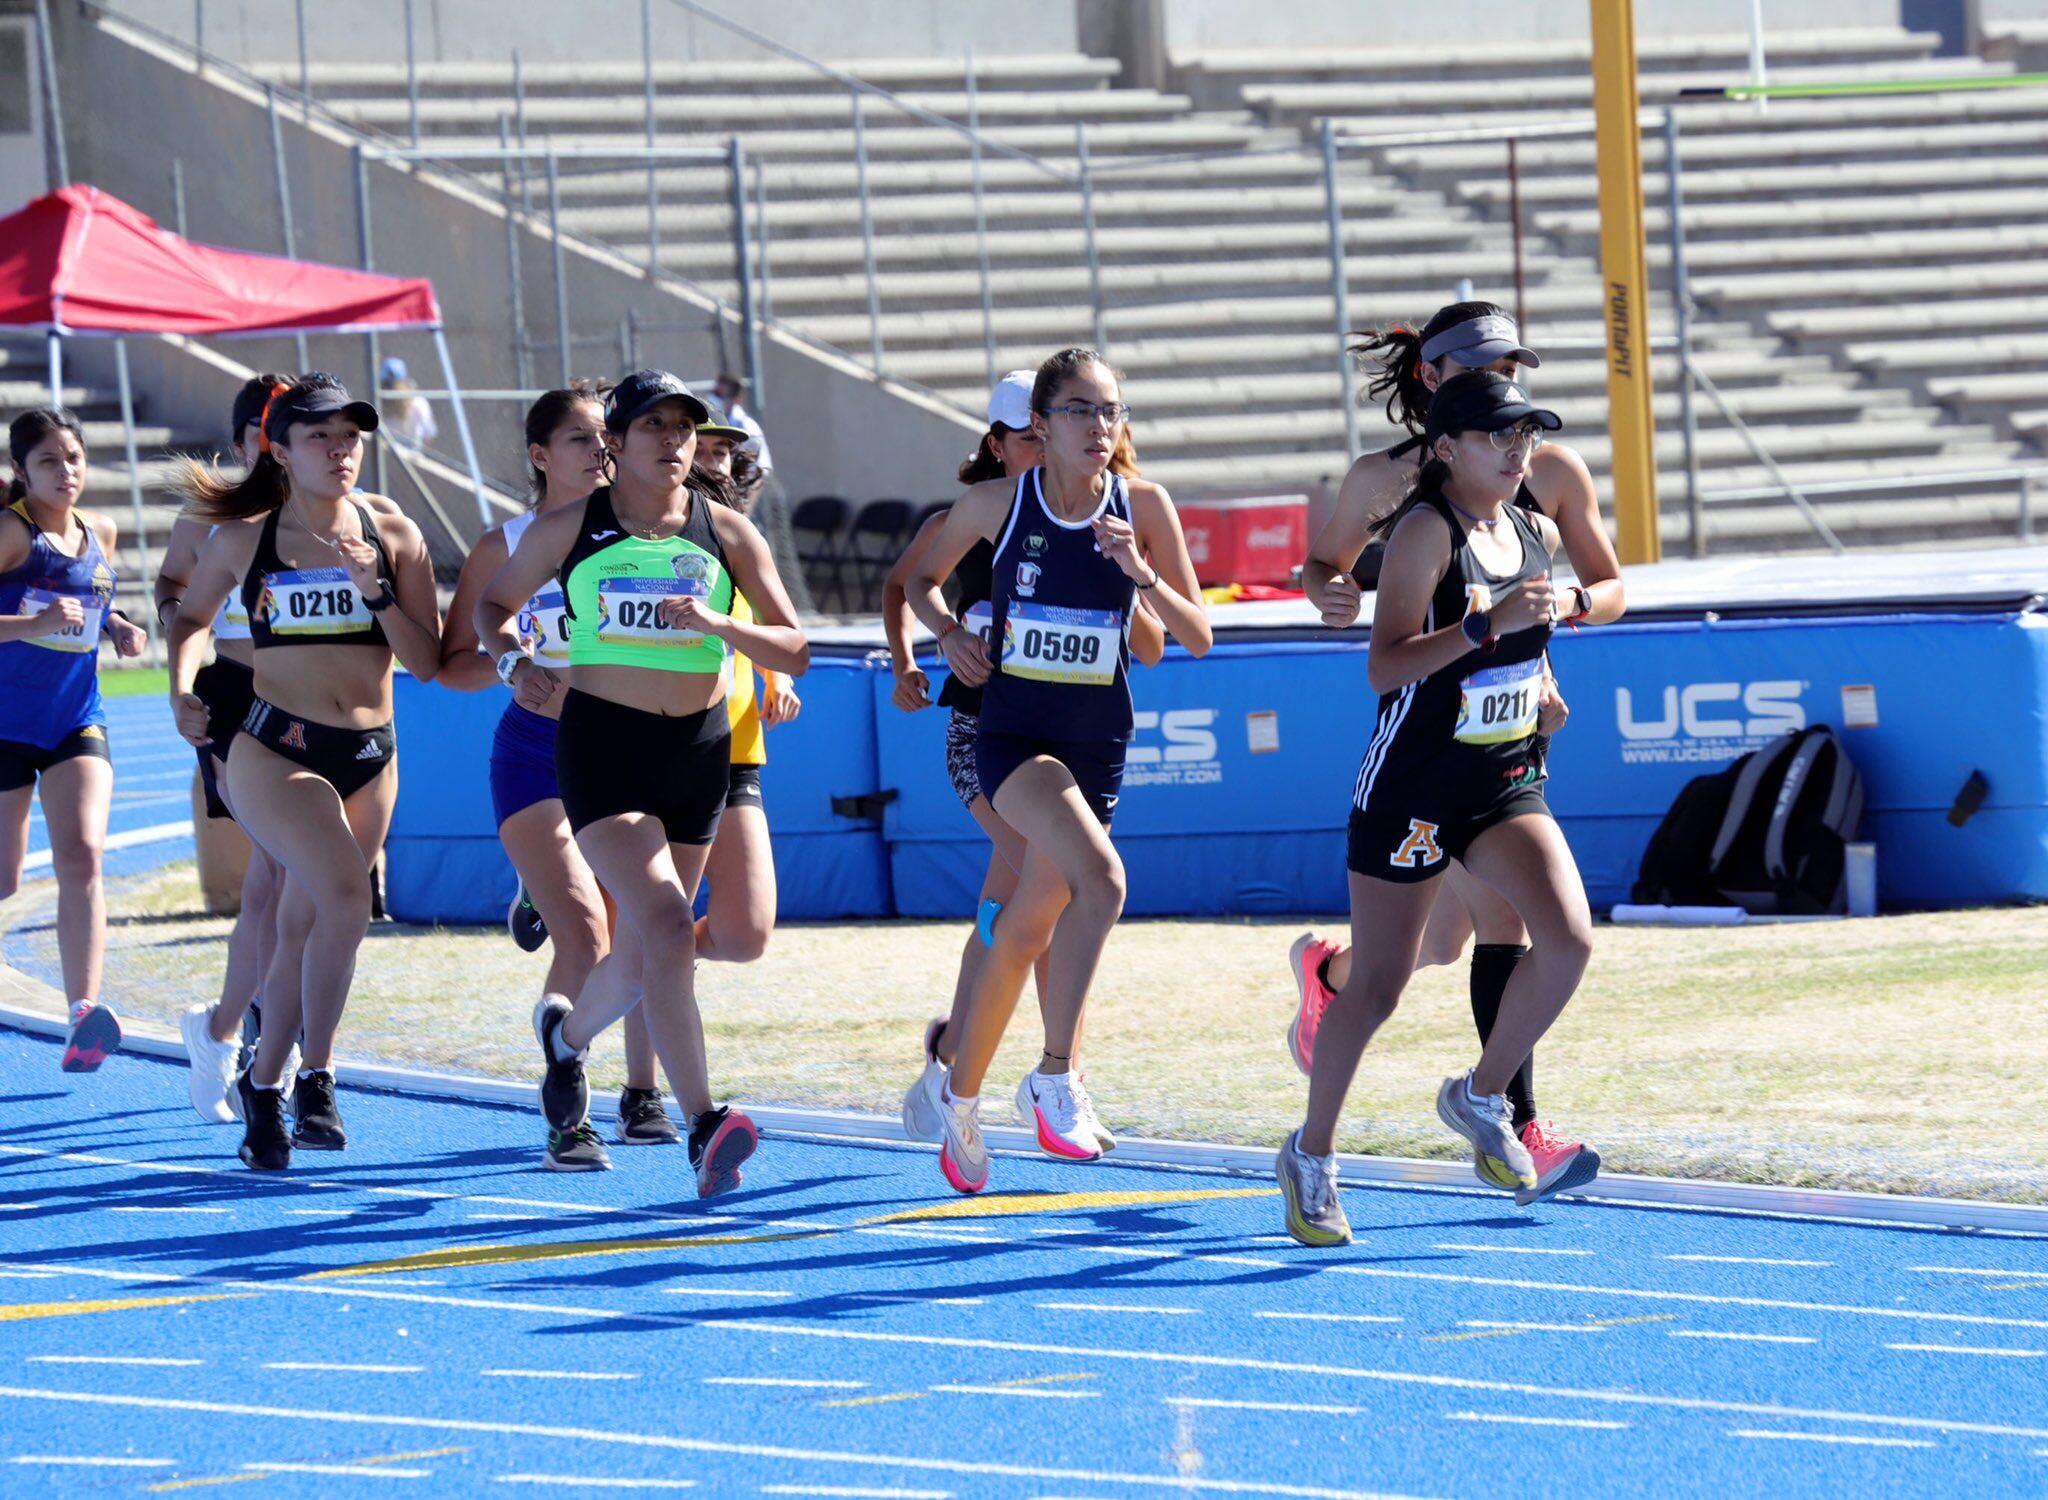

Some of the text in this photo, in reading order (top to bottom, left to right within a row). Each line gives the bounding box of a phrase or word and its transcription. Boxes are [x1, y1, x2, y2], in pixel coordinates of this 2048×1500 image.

[630, 577, 679, 585] UNIVERSIADA
[635, 583, 674, 591] NACIONAL
[289, 589, 353, 618] 0218
[1023, 629, 1100, 664] 0599
[1481, 688, 1529, 725] 0211
[1616, 680, 1806, 740] UCS
[1126, 709, 1217, 763] CS
[1390, 817, 1443, 867] A
